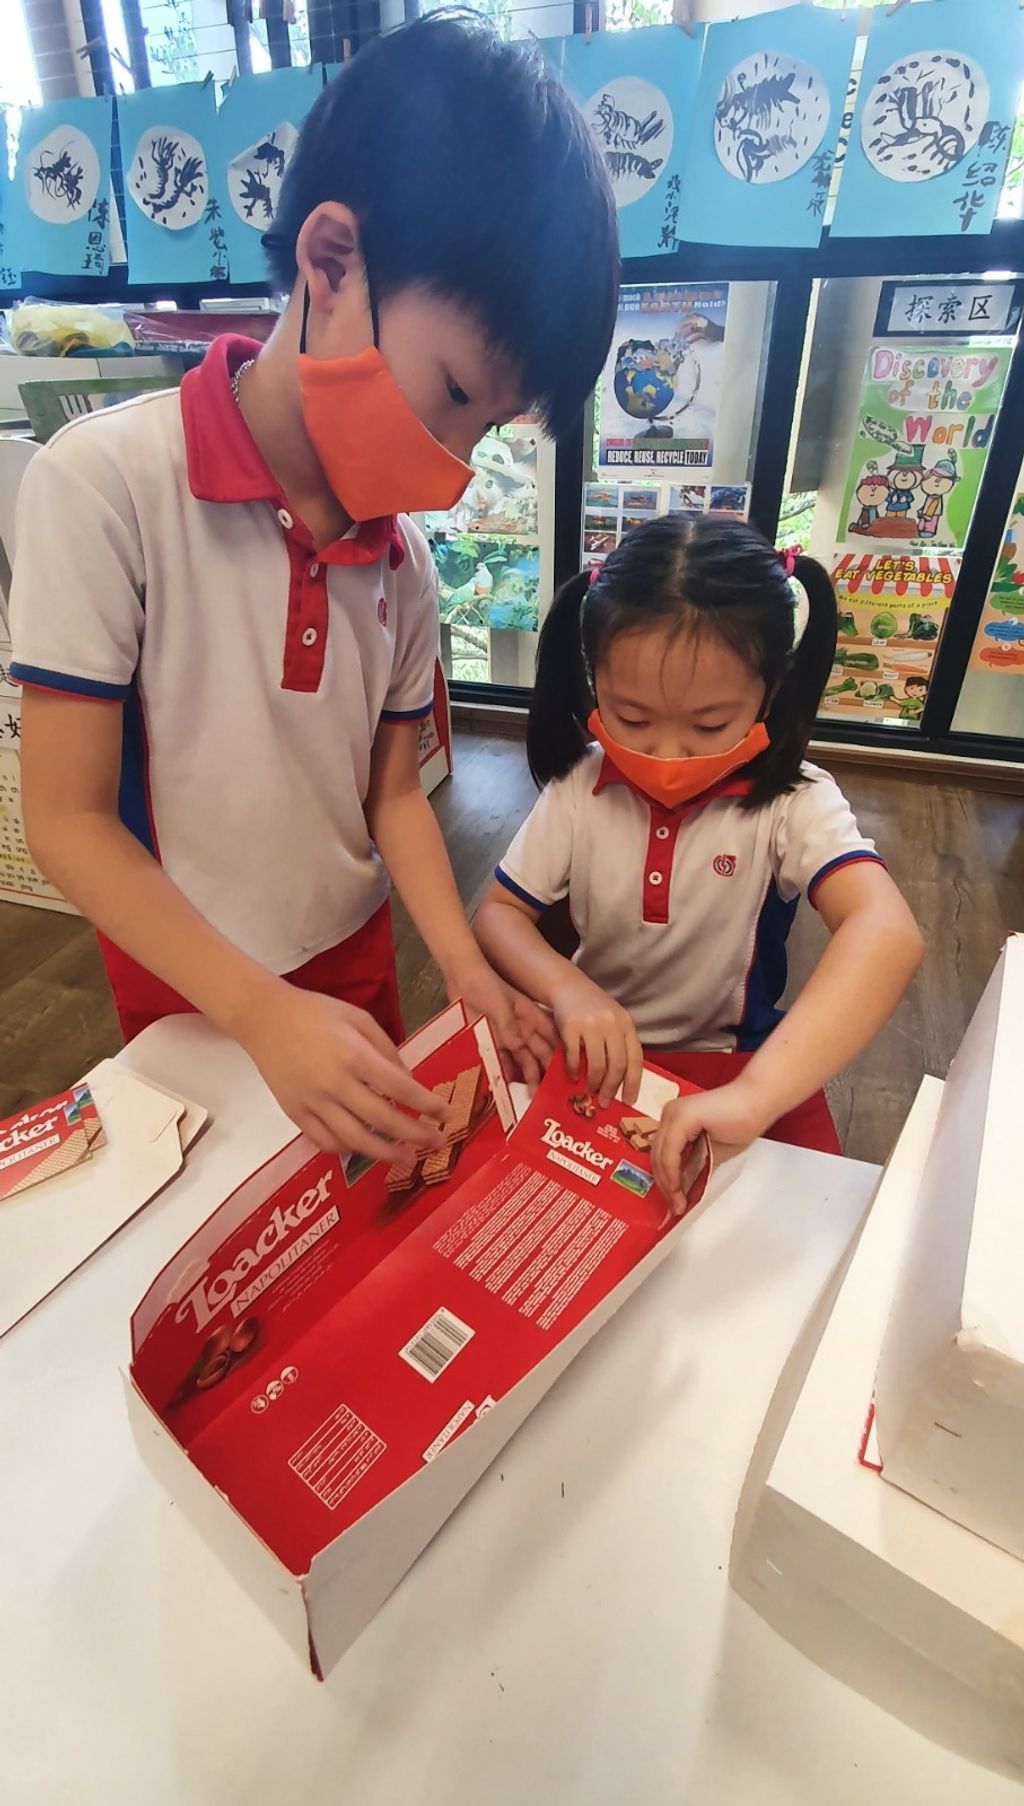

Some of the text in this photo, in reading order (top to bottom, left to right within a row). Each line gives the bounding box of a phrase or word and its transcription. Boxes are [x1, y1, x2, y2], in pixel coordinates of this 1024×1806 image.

[905, 293, 993, 324] 探索区
[873, 349, 998, 388] Discovery
[888, 379, 972, 411] of the
[905, 414, 995, 448] World
[656, 451, 684, 464] RECYCLE
[685, 450, 707, 465] TODAY
[834, 568, 952, 584] EAT VEGETABLES
[875, 559, 916, 571] LET'S
[0, 1116, 58, 1153] cker
[541, 1117, 614, 1170] Loacker
[174, 1169, 333, 1334] Loacker
[235, 1210, 337, 1312] NAPOLITANER
